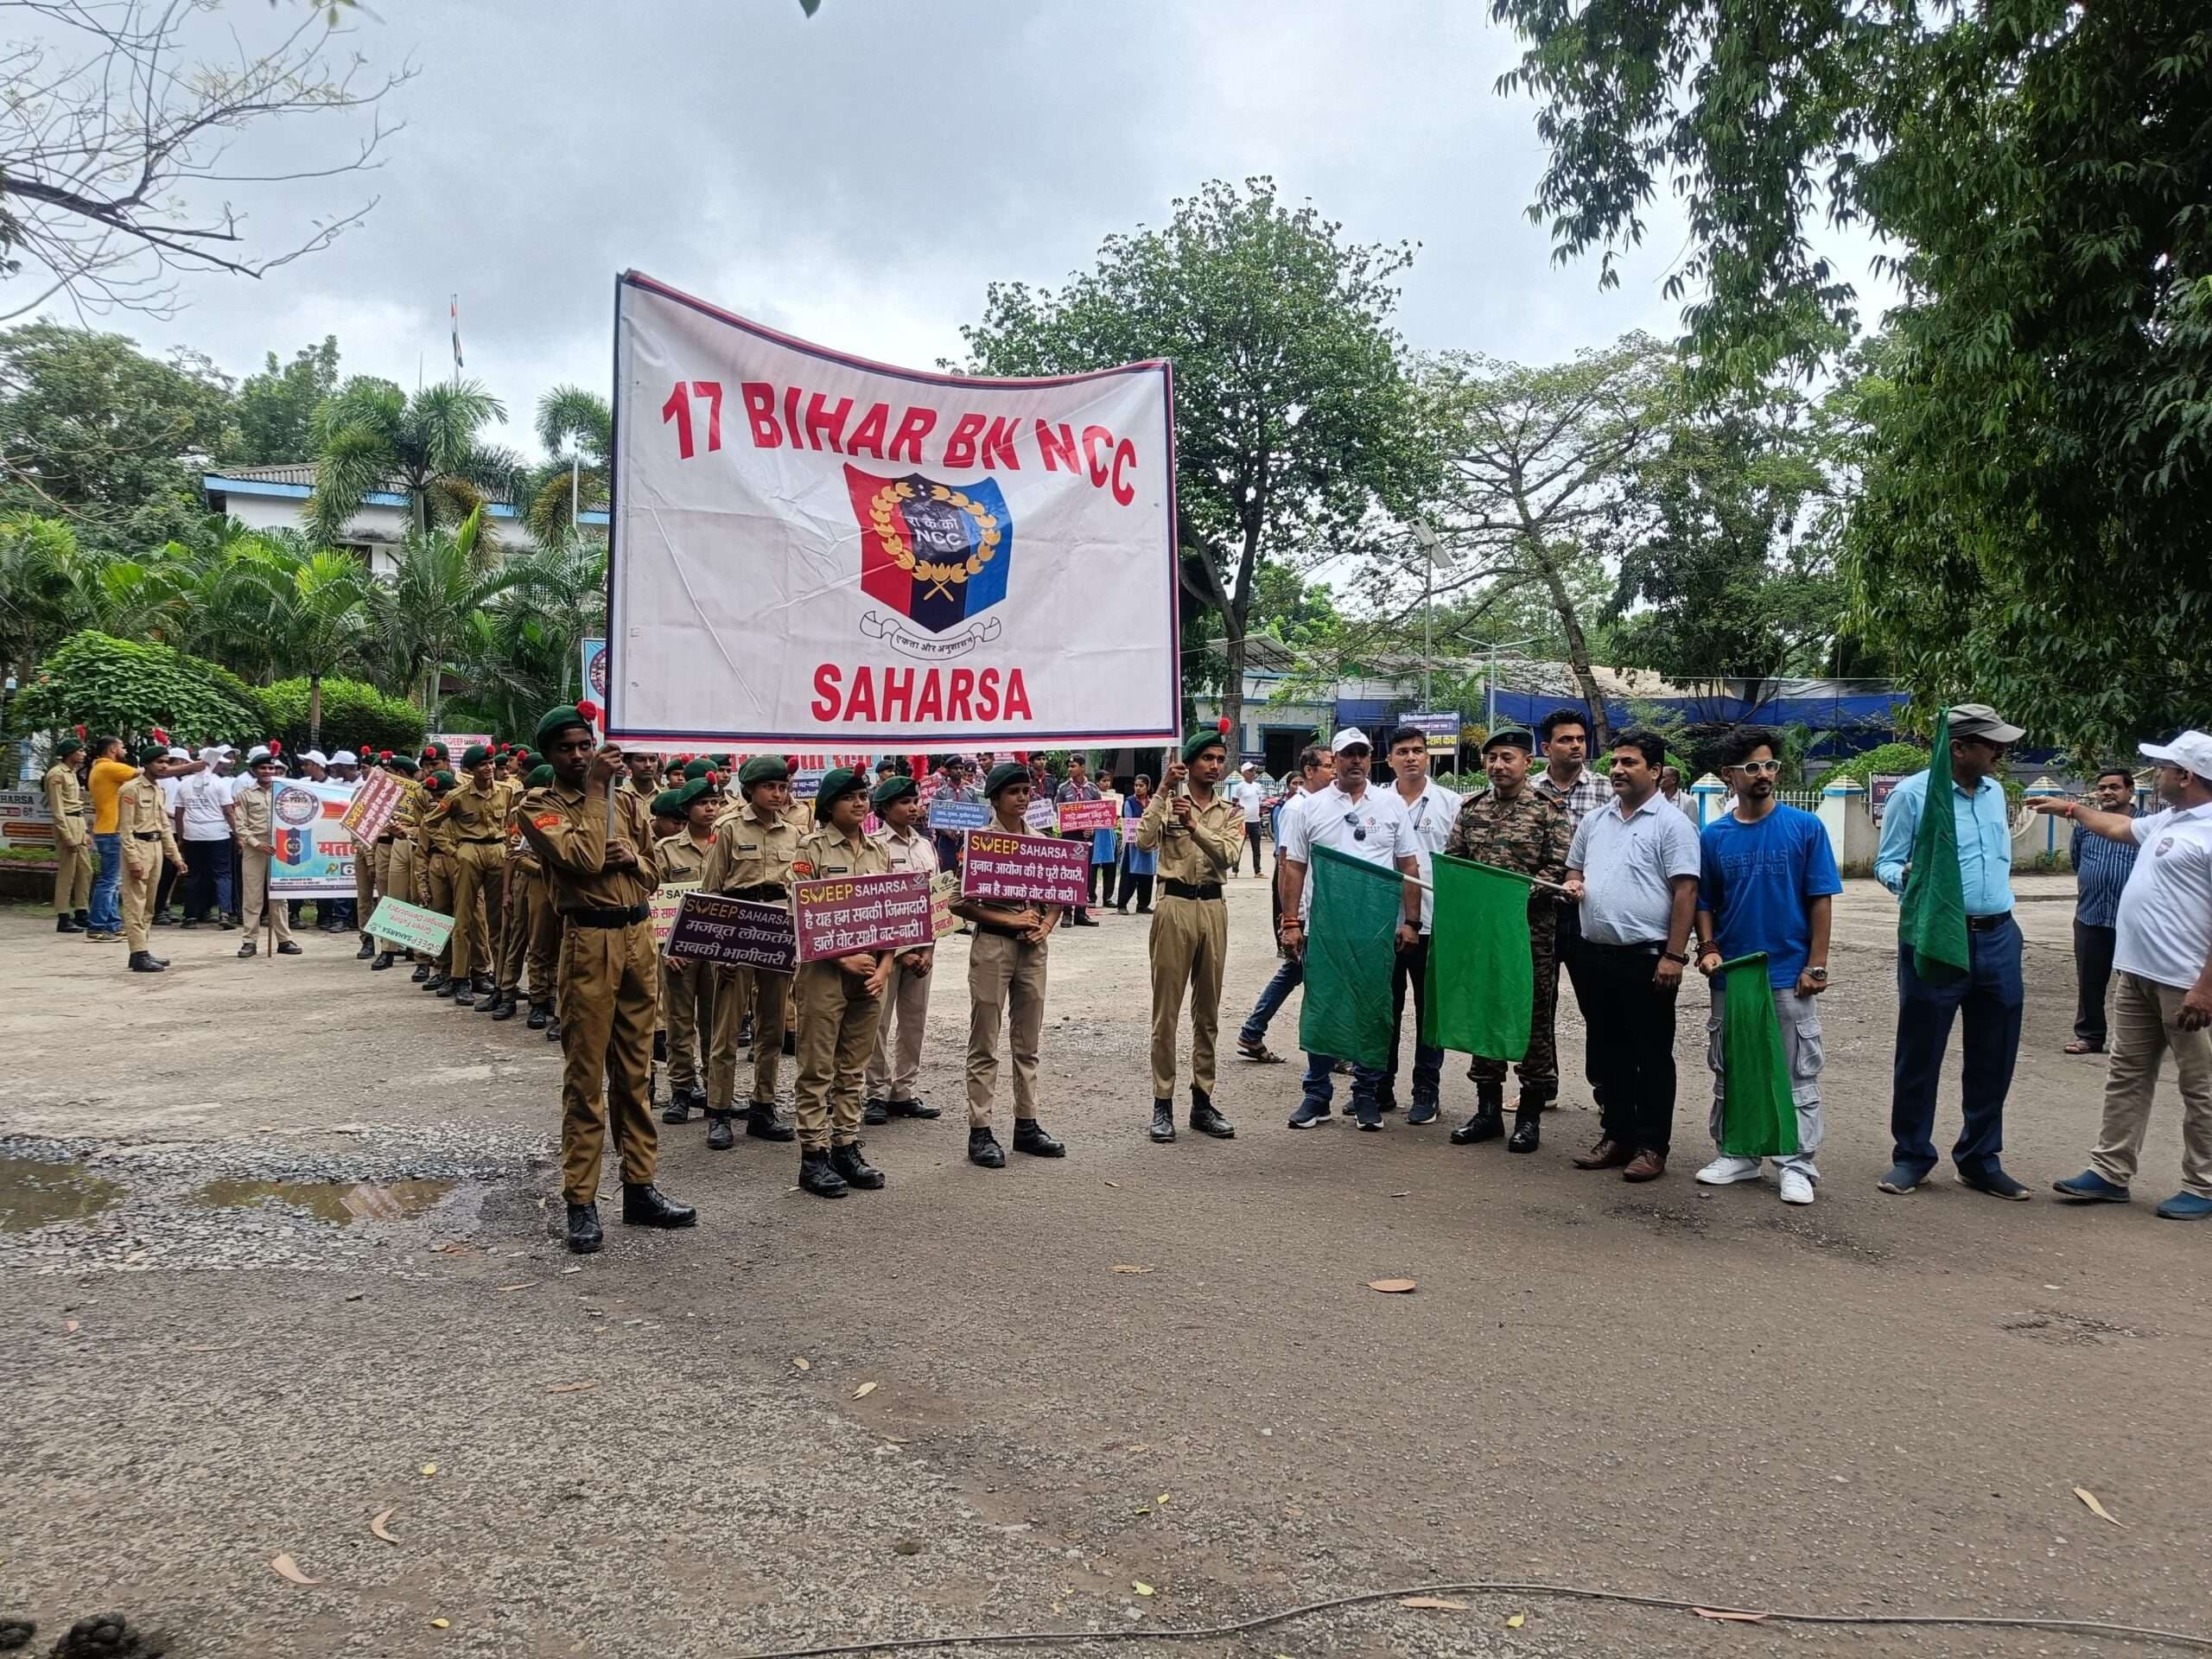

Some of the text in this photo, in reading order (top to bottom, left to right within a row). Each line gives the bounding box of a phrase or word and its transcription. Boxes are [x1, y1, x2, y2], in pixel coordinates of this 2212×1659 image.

[662, 382, 1137, 506] 17 BIHAR BN NCC
[914, 529, 962, 545] NCC
[896, 634, 973, 654] एकता और अनुशासन
[811, 663, 1033, 722] SAHARSA
[0, 795, 35, 804] HARSA
[970, 836, 1068, 859] SWEEP SAHARSA
[793, 863, 810, 872] NCC
[969, 859, 1084, 884] चुनाव आयोग की है पूरी तैयारी,
[800, 884, 854, 905] SWEEP
[855, 880, 908, 898] SAHARSA
[976, 882, 992, 895] अब
[994, 880, 1001, 897] है
[1002, 883, 1027, 899] आपके
[1029, 884, 1045, 899] वोट
[1045, 885, 1057, 900] की
[684, 899, 790, 926] SWEEP SAHARSA
[804, 909, 813, 930] है
[816, 912, 831, 927] यह
[834, 909, 850, 927] हम
[852, 900, 883, 923] सबकी
[383, 926, 413, 942] SAHARSA
[686, 919, 736, 940] मजबूत
[813, 929, 835, 952] डालें
[836, 930, 855, 948] वोट
[856, 925, 879, 946] सभी
[880, 918, 924, 941] नर-नारी।
[675, 940, 721, 957] सबकी
[722, 946, 787, 966] भागीदारी
